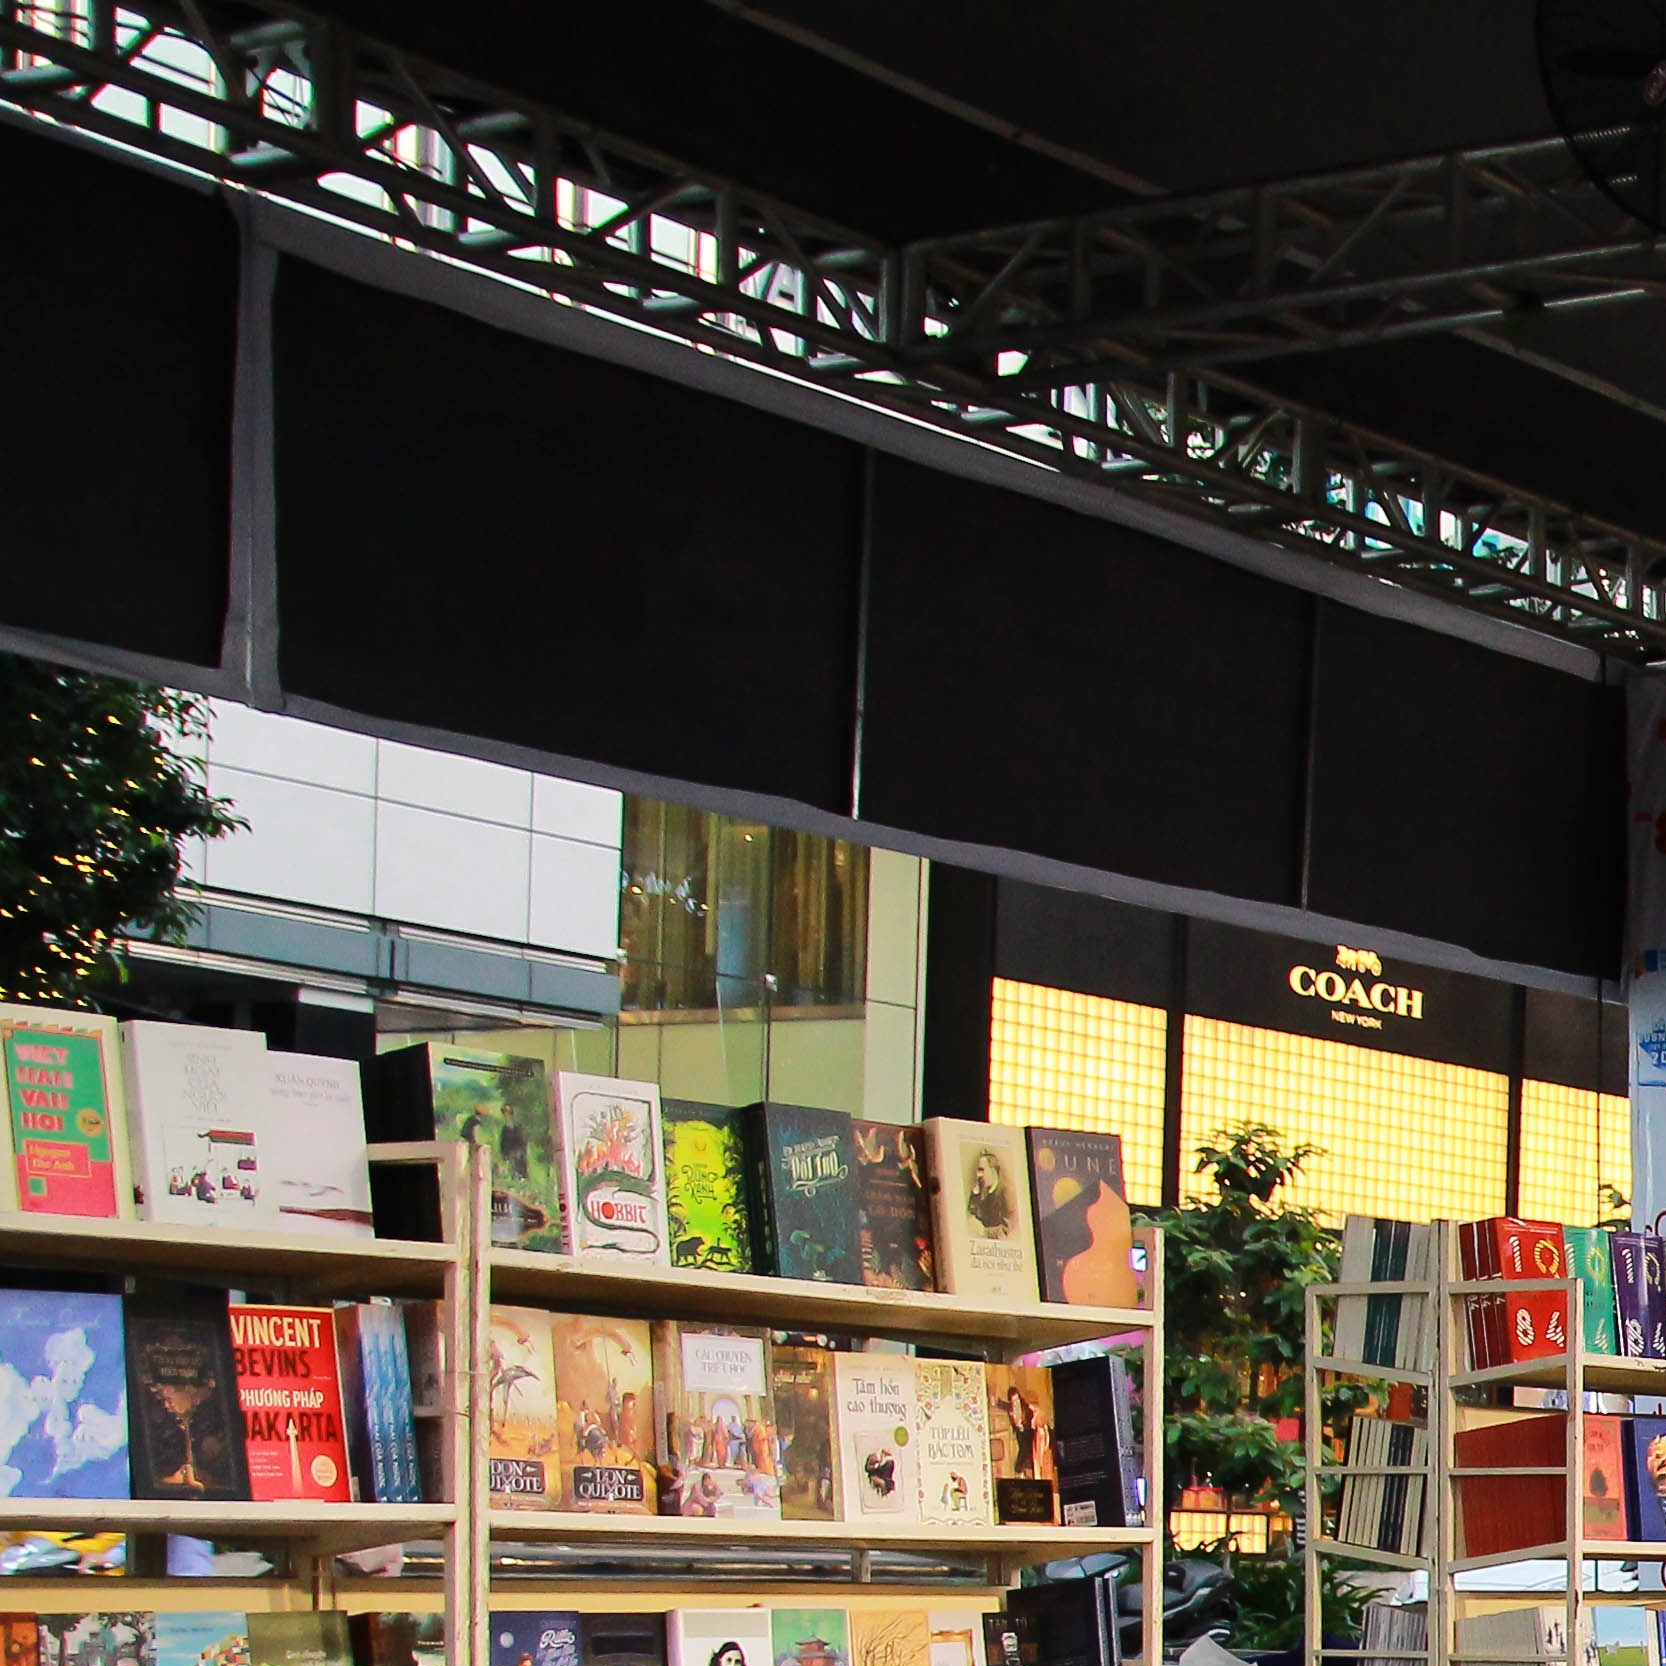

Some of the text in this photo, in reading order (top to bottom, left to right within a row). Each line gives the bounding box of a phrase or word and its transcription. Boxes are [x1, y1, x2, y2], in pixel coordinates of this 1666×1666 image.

[1289, 964, 1424, 1020] COACH
[1331, 1010, 1383, 1030] NEW YORK
[1044, 1152, 1117, 1177] UNE
[589, 1199, 648, 1225] HOBBIT
[229, 1316, 322, 1349] VINCENT
[234, 1347, 310, 1379] BEVINS
[292, 1388, 324, 1409] PHÁP
[847, 1399, 867, 1413] cao
[596, 1469, 626, 1486] DON
[579, 1480, 642, 1500] QUIXOTE
